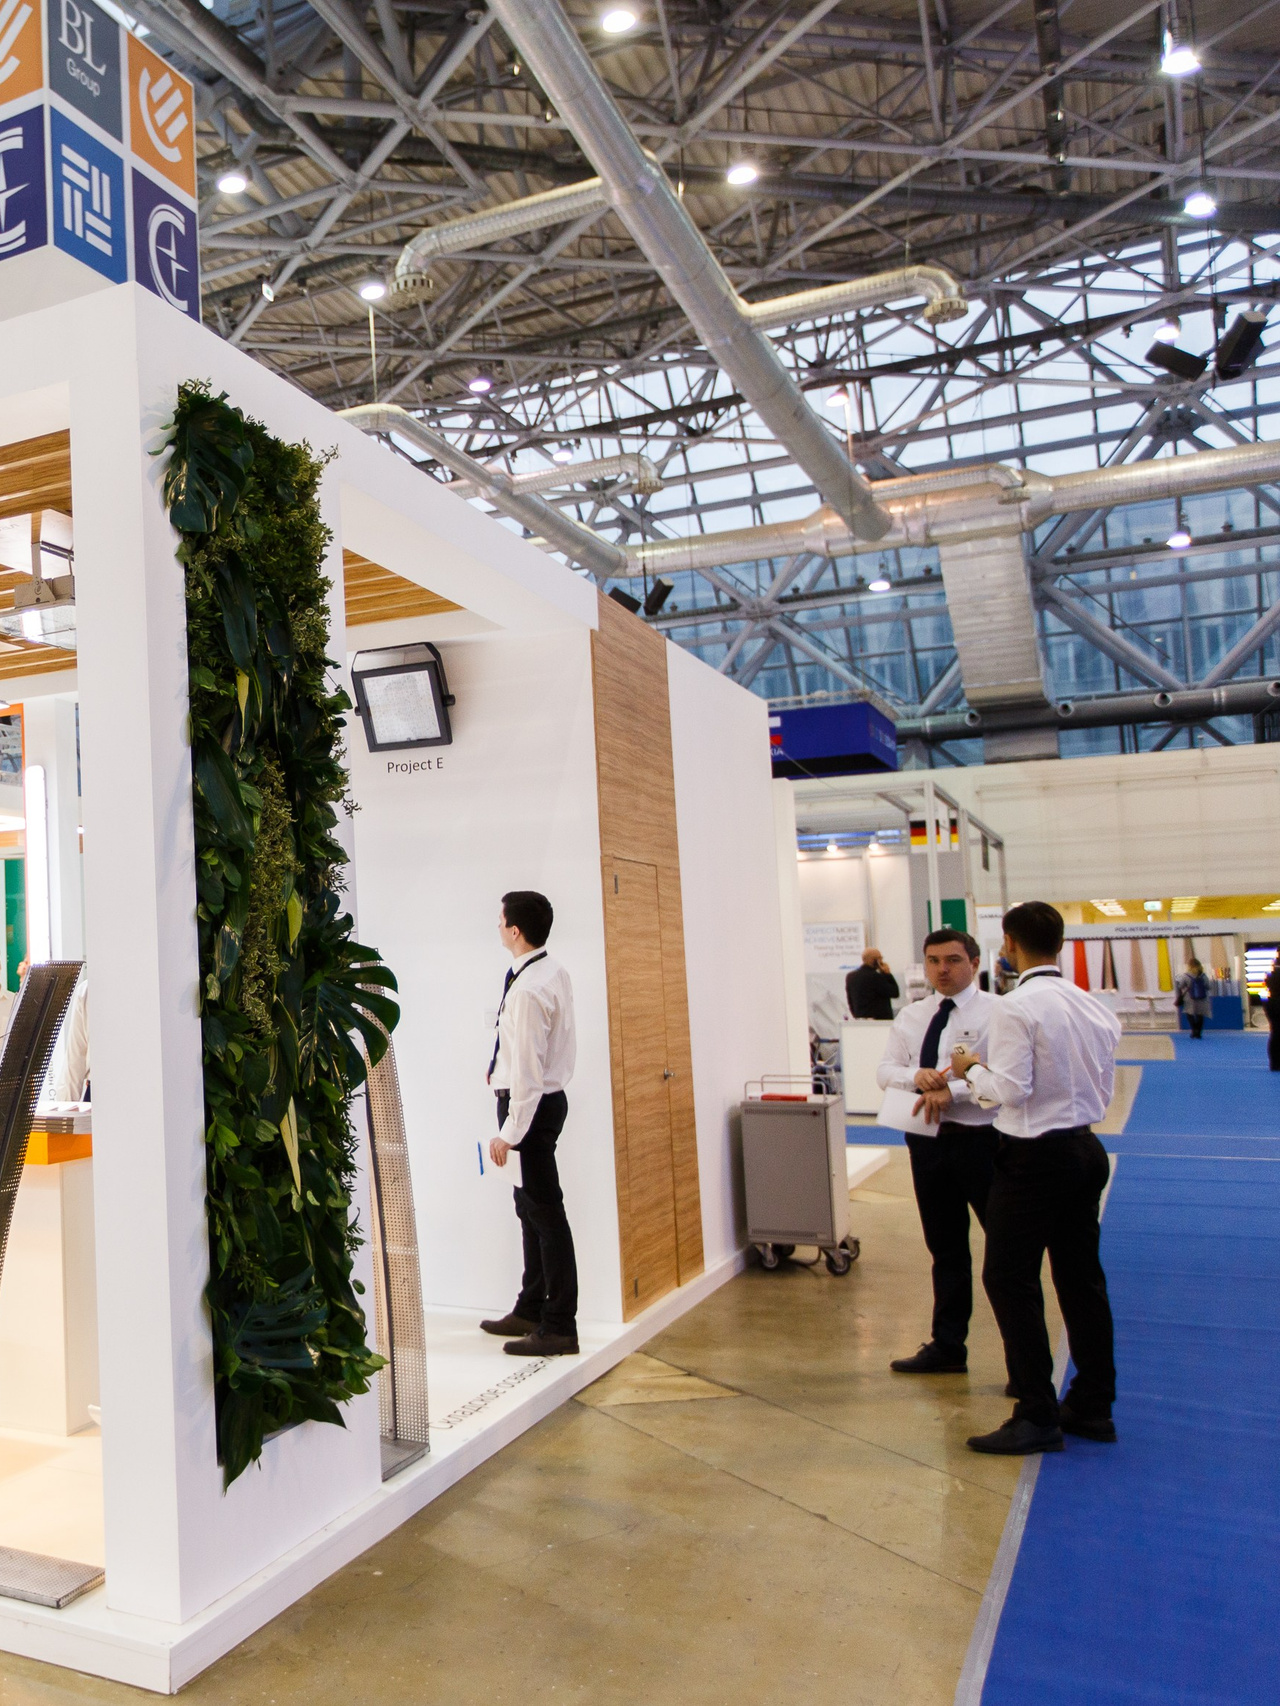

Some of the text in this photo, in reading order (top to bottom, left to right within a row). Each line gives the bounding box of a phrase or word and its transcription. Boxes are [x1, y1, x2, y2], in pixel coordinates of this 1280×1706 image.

[58, 0, 107, 76] BL
[66, 57, 100, 97] Group
[387, 757, 444, 774] Project E
[428, 1387, 507, 1430] Складское
